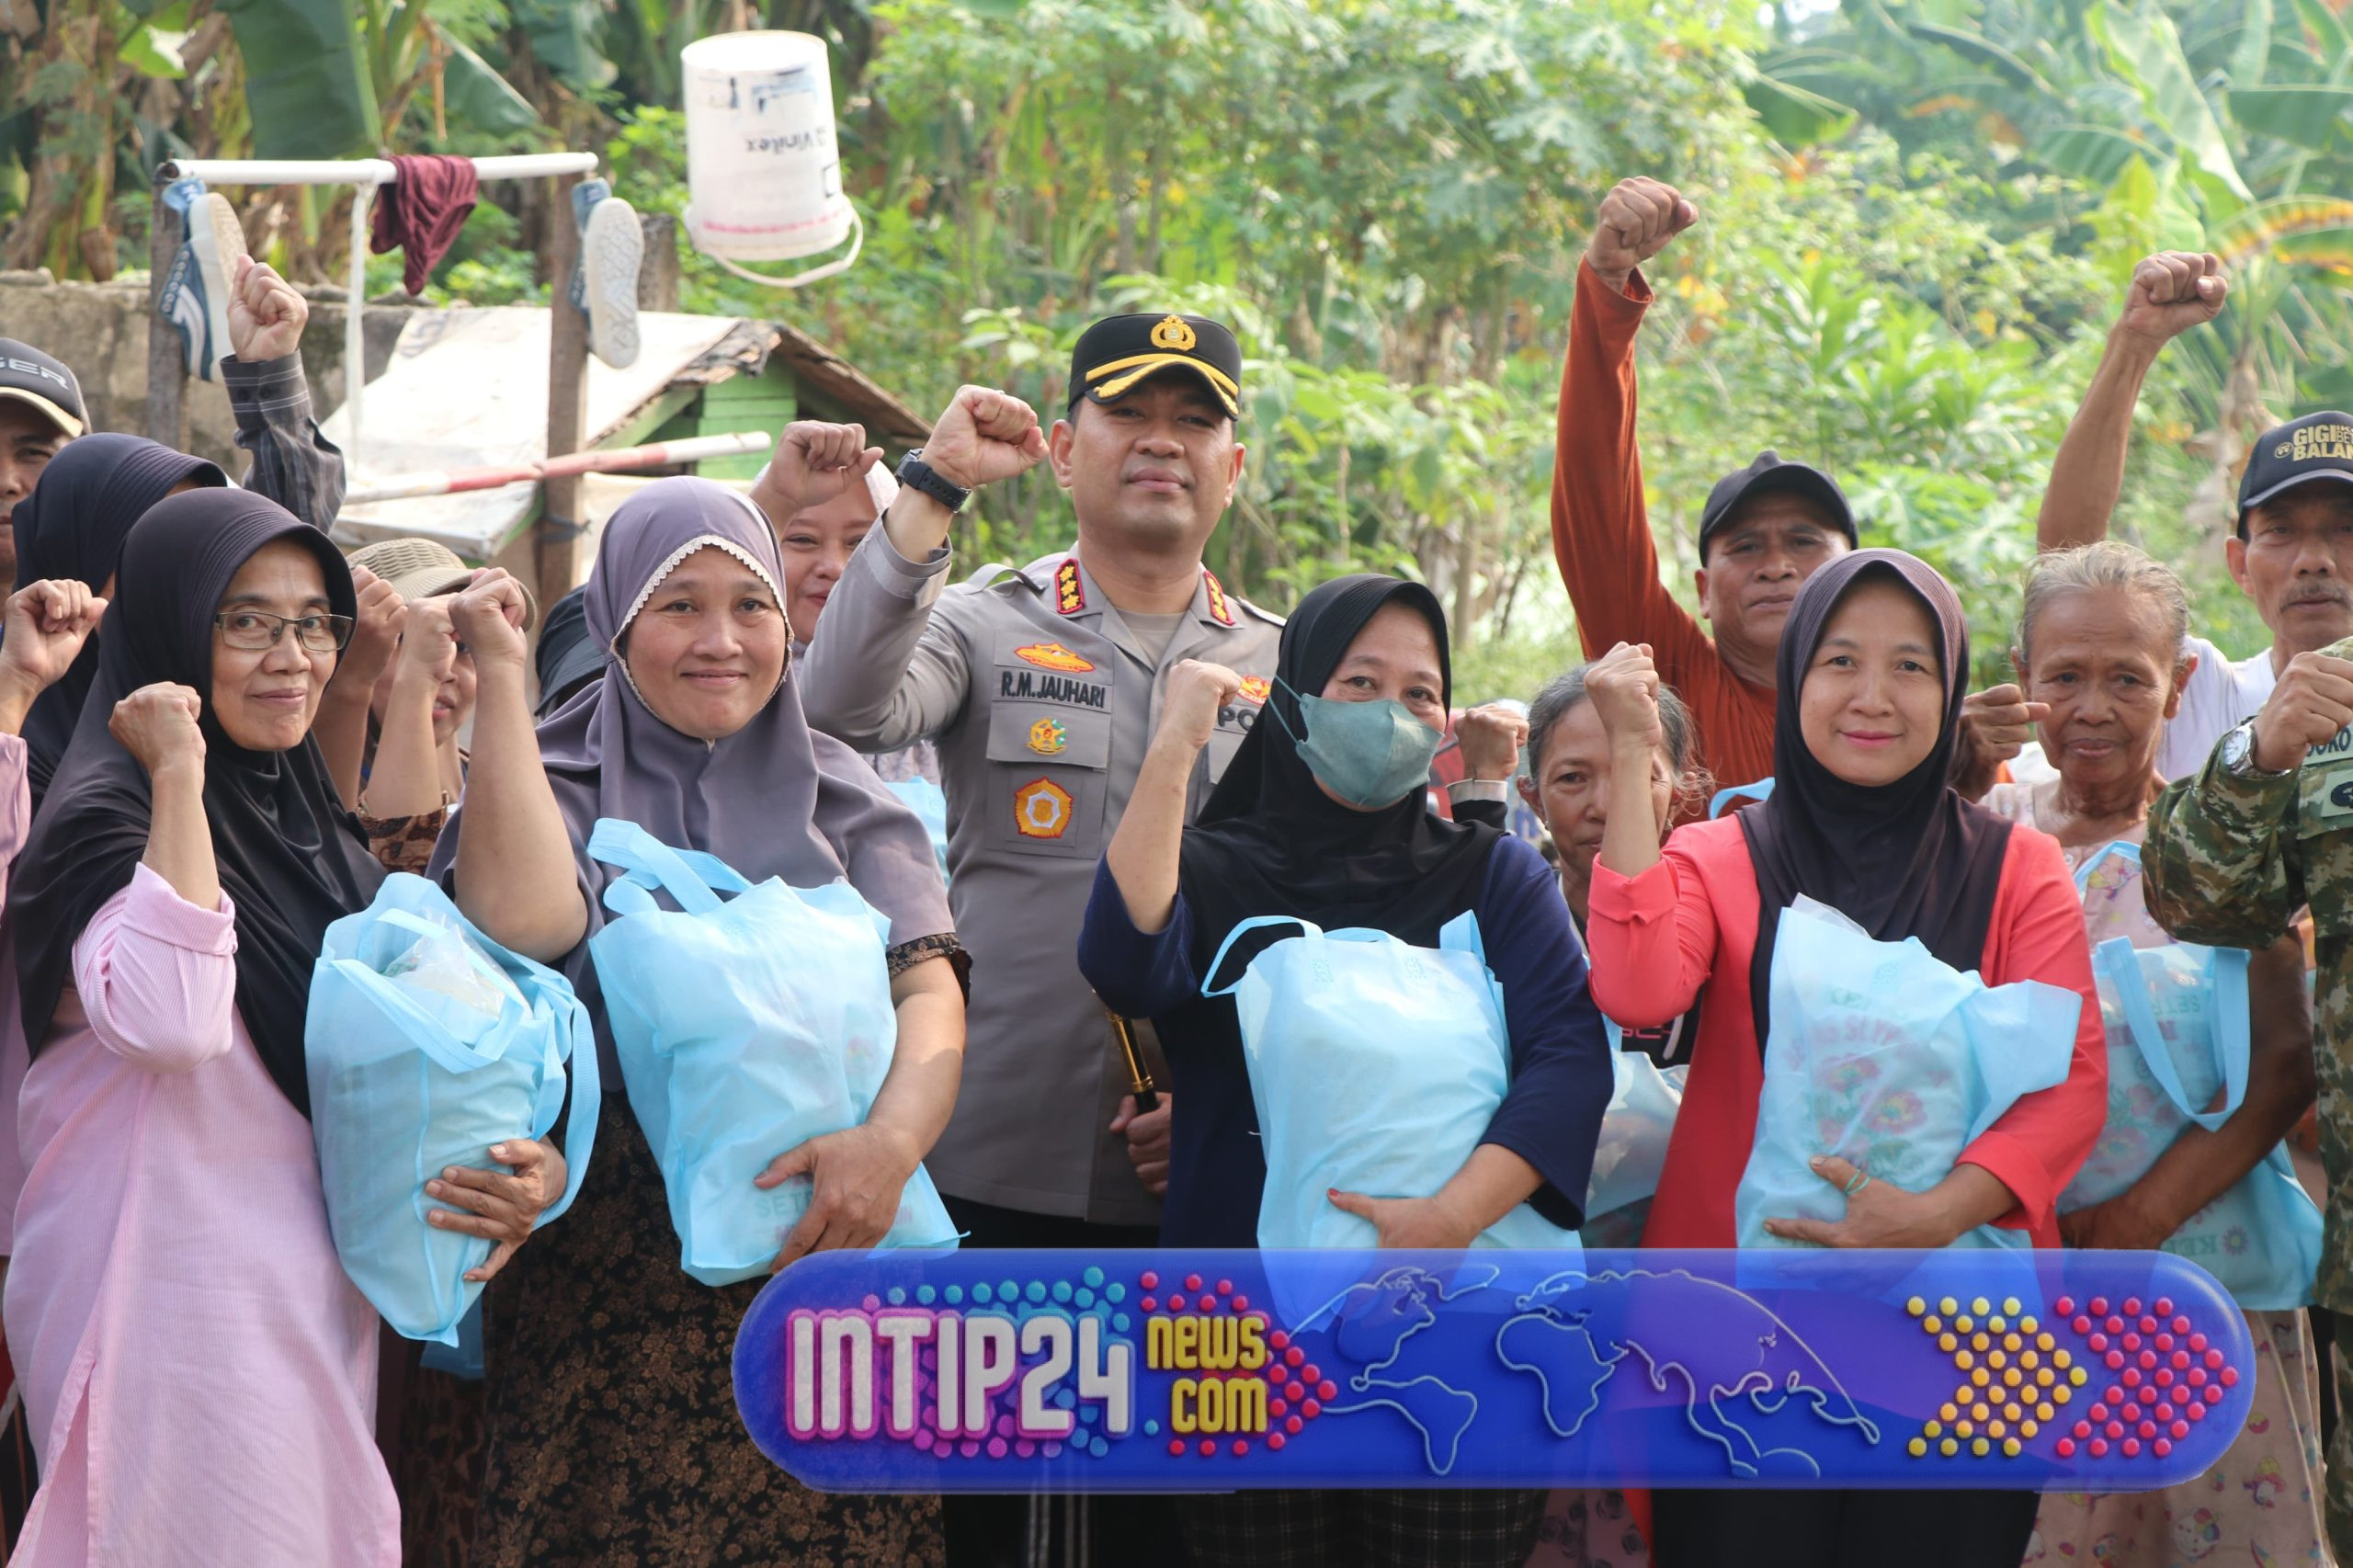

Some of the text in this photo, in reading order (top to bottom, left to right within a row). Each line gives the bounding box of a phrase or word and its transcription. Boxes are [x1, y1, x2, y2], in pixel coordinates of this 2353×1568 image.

[0, 357, 70, 391] ER
[2293, 424, 2337, 447] GIGI
[1001, 670, 1106, 709] R.M.JAUHARI
